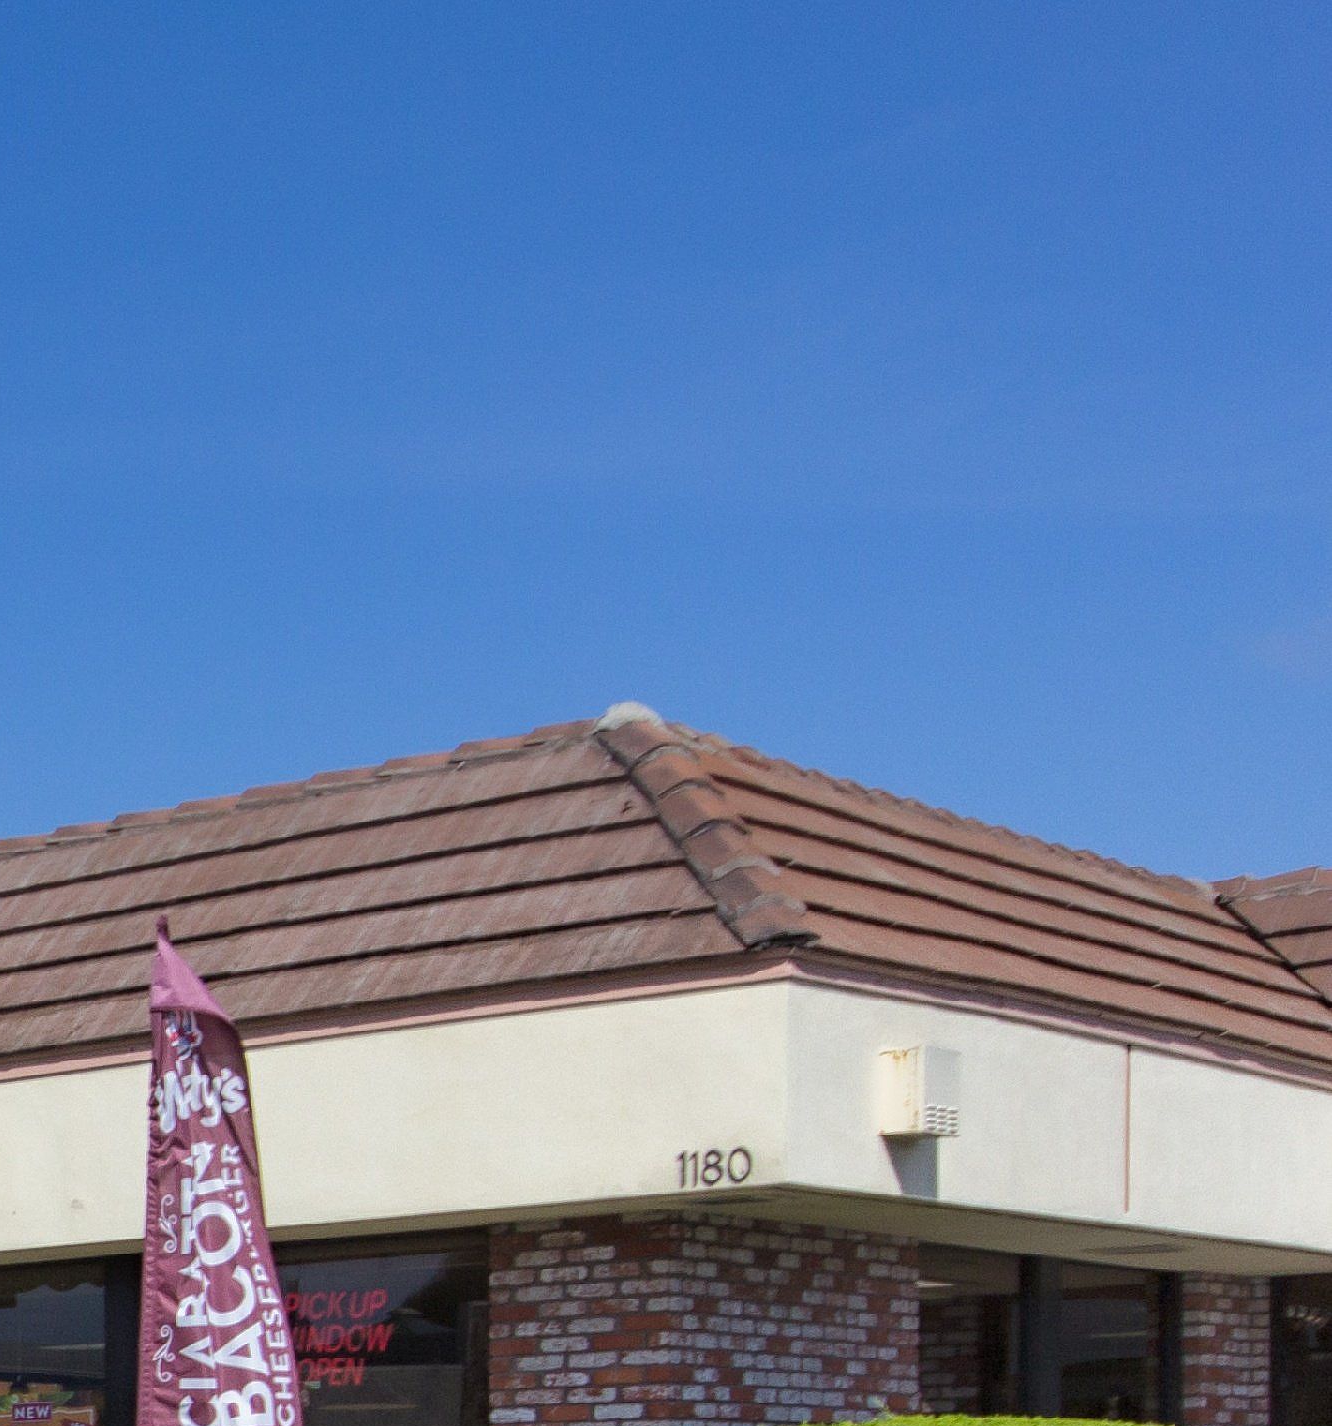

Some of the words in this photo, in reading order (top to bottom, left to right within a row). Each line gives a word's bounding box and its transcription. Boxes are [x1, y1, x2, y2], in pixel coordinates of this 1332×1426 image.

[677, 1146, 753, 1188] 1180
[284, 1290, 347, 1320] PICK
[349, 1288, 388, 1319] UP
[294, 1323, 394, 1353] INDOW
[297, 1357, 364, 1387] OPEN
[15, 1405, 50, 1419] NEW
